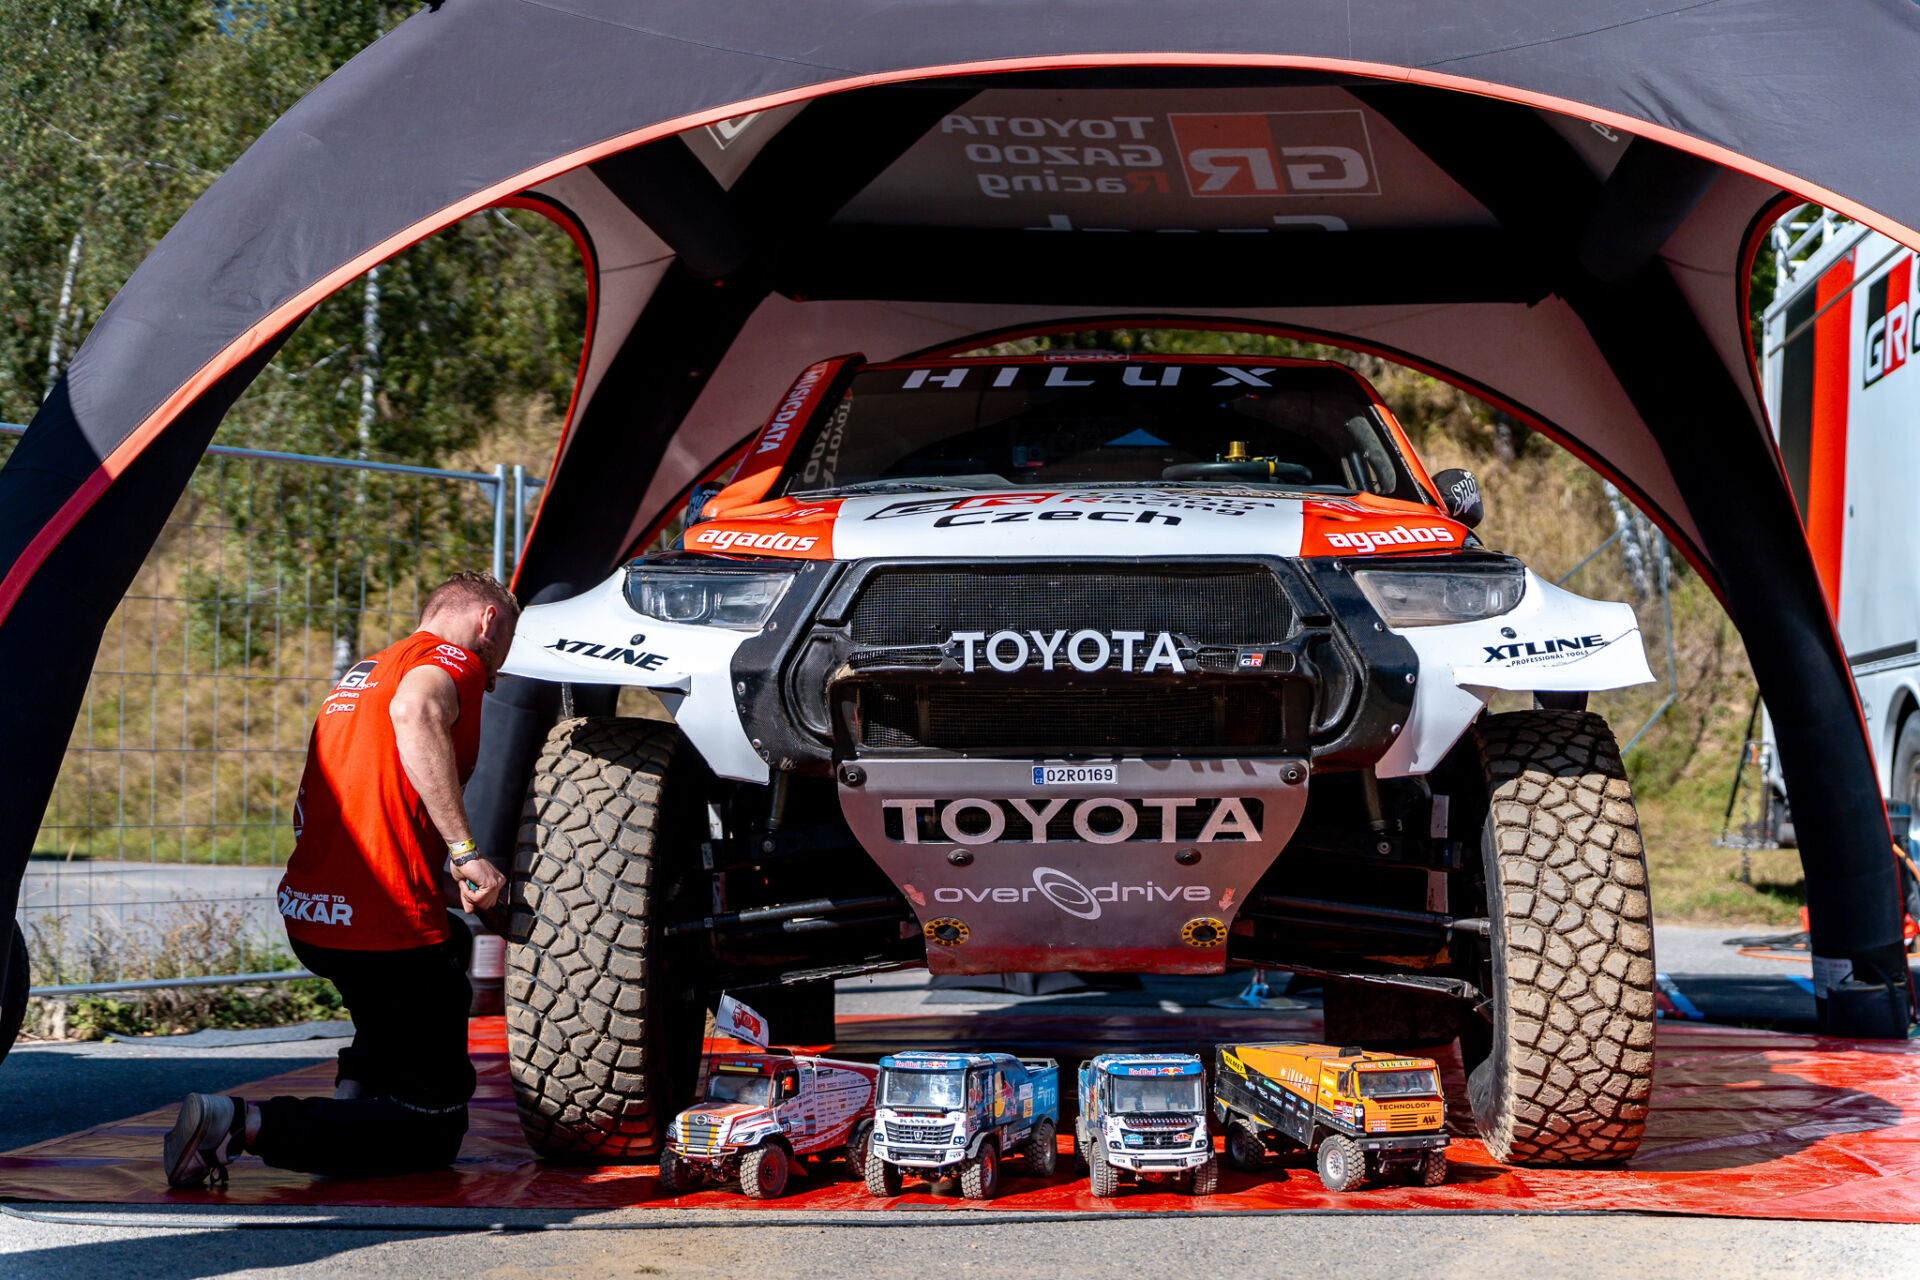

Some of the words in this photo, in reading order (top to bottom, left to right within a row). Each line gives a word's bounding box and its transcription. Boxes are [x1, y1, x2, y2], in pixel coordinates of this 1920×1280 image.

[1865, 301, 1909, 385] GR
[902, 366, 1278, 389] HILUX
[756, 369, 824, 455] MUSICDATA
[933, 508, 1182, 528] Czech
[696, 528, 819, 552] agados
[1324, 525, 1455, 554] agados
[544, 637, 669, 671] XTLINE
[952, 629, 1187, 674] TOYOTA
[1483, 634, 1606, 664] XTLINE
[1511, 652, 1564, 667] PROFESSIONAL
[1566, 650, 1590, 659] TOOLS
[1046, 768, 1113, 782] 02R0169
[883, 797, 1262, 845] TOYOTA
[278, 891, 353, 926] DAKAR
[331, 895, 345, 903] TO
[1225, 1055, 1243, 1072] SILMET
[1378, 1102, 1431, 1110] TECHNOLOGY
